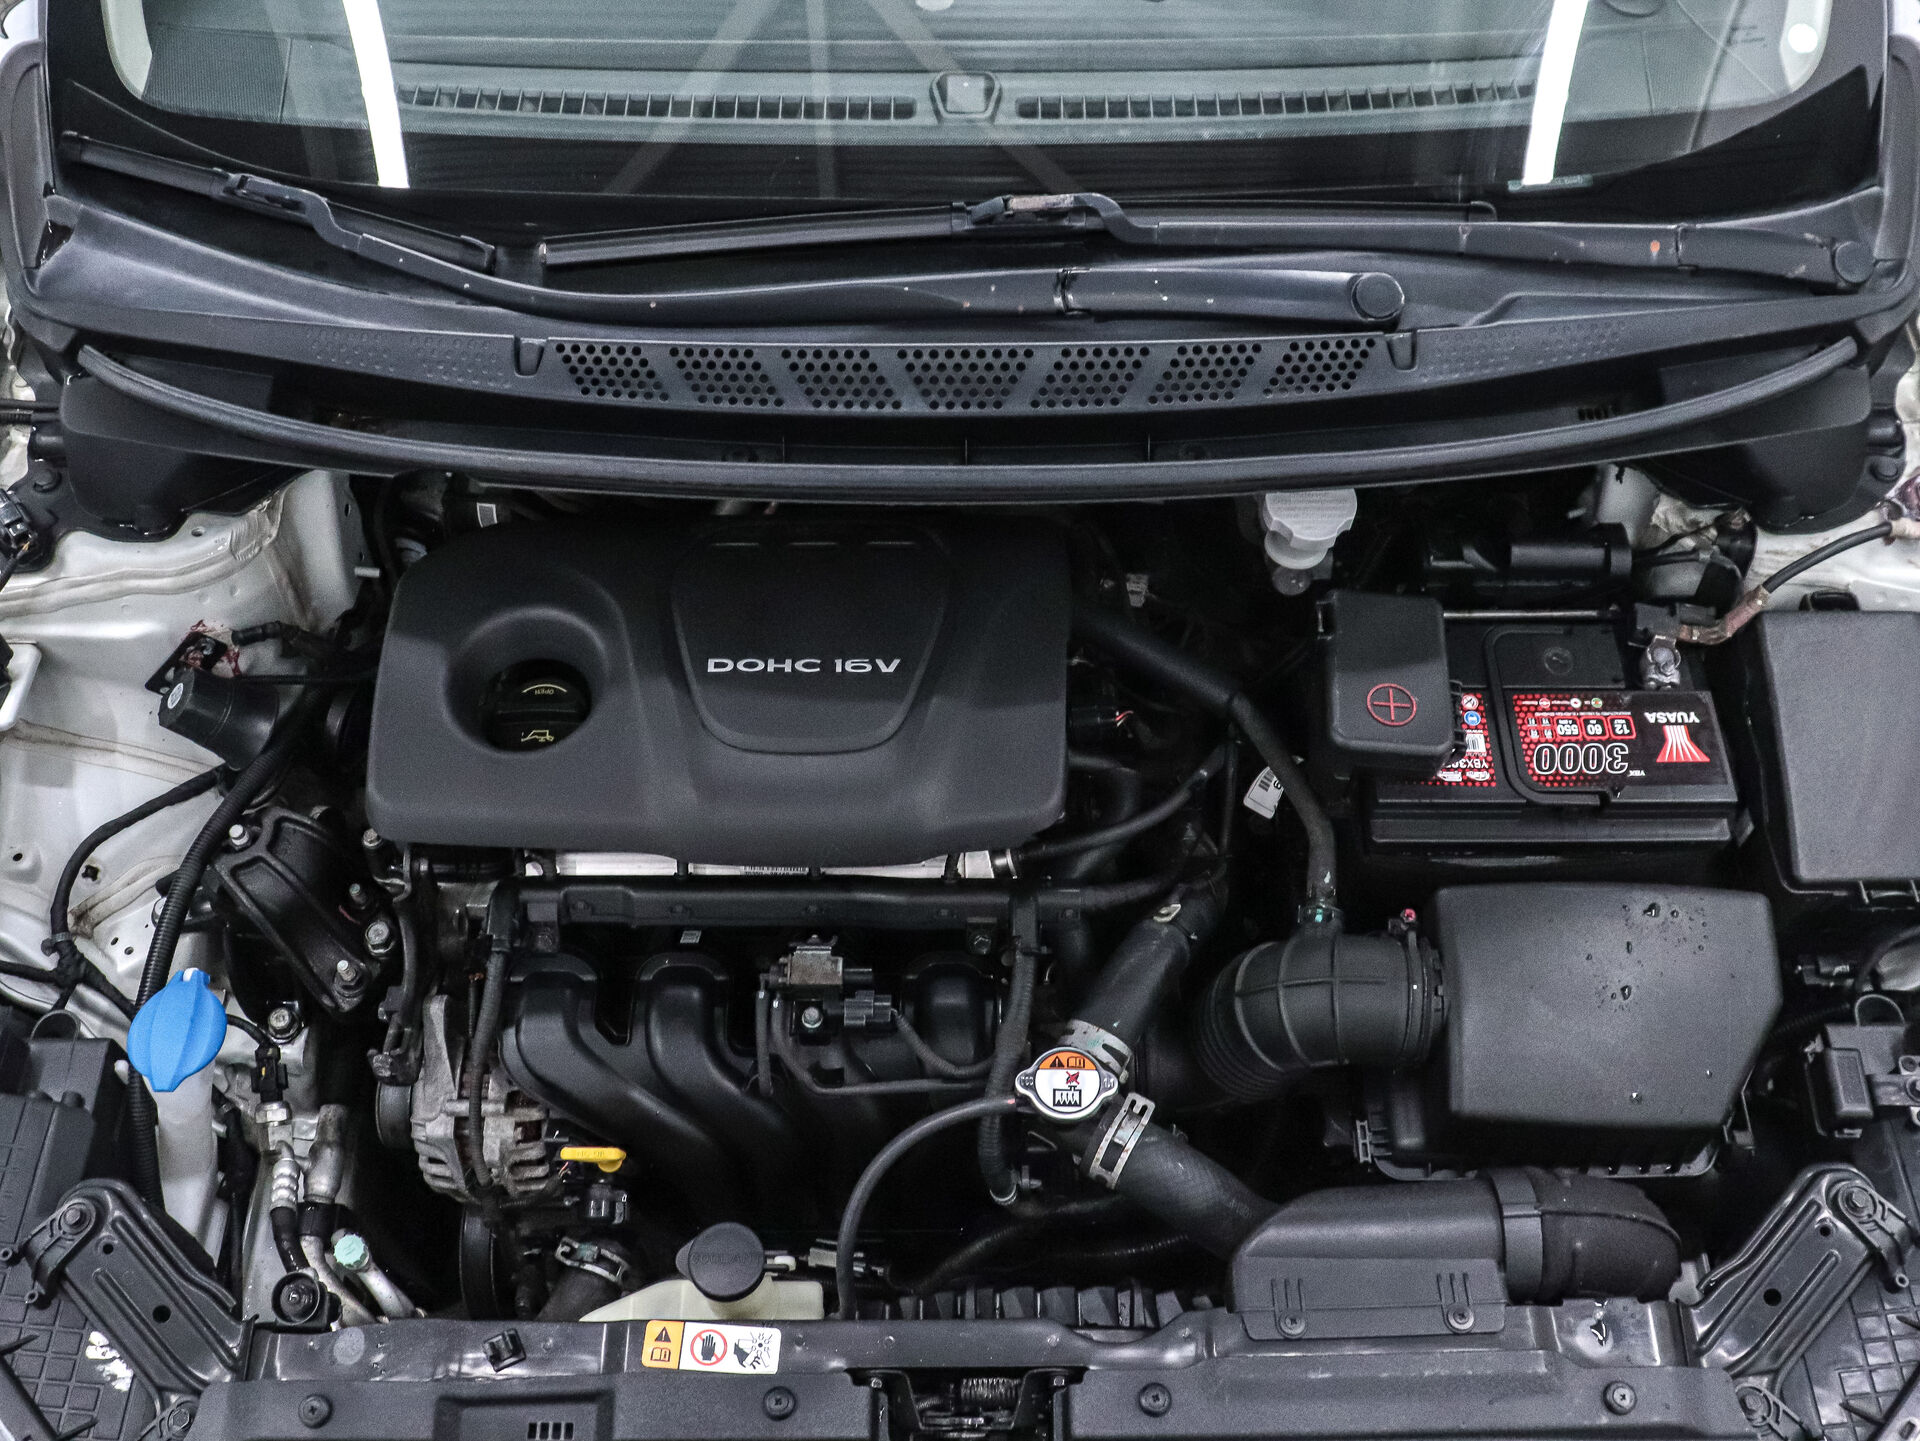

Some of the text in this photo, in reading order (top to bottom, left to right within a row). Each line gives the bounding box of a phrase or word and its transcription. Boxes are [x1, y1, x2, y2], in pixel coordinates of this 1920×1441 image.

[707, 658, 901, 673] DOHC 16V
[534, 688, 554, 696] OPEN
[1644, 711, 1700, 724] YUASA
[1557, 724, 1579, 735] 550
[1587, 724, 1603, 735] 60
[1614, 724, 1630, 735] 12
[1533, 743, 1629, 775] 3000
